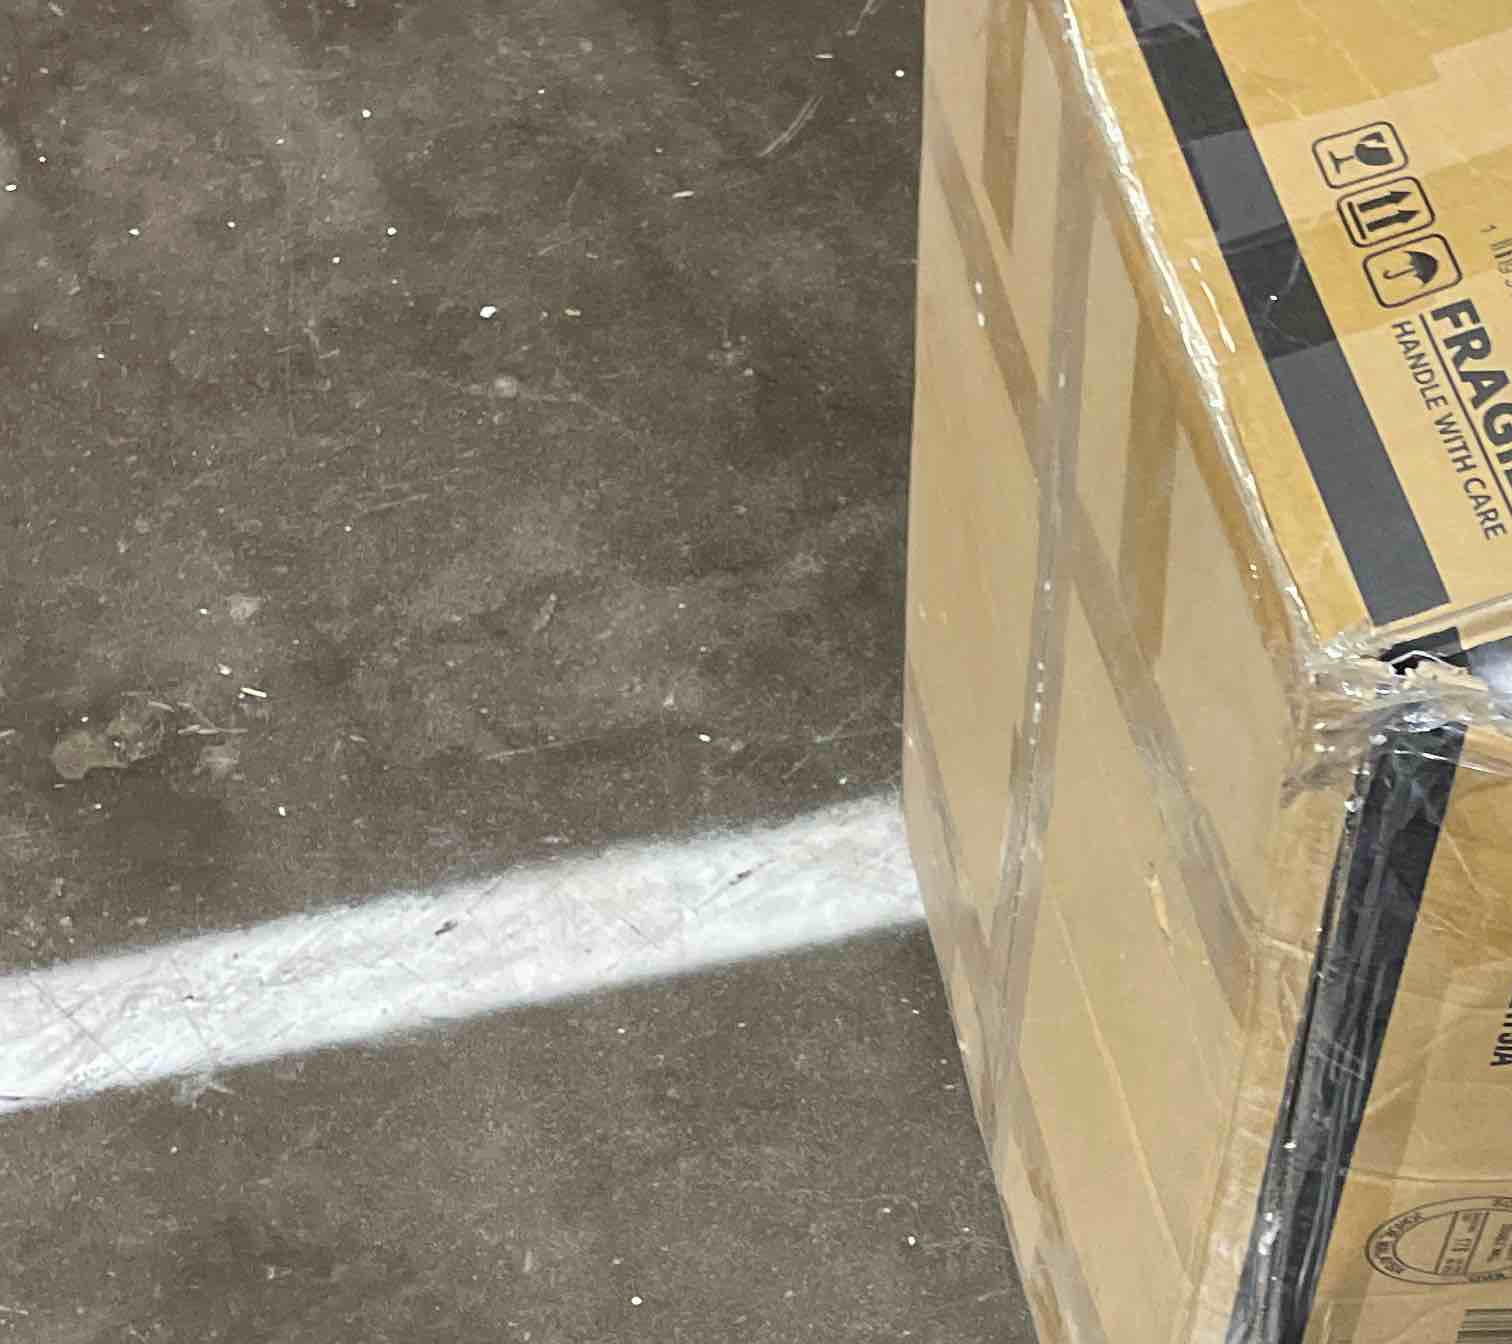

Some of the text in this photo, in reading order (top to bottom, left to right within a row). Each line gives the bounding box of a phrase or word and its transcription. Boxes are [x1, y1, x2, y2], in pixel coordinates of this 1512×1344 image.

[1388, 318, 1508, 541] HANDLE WITH CARE
